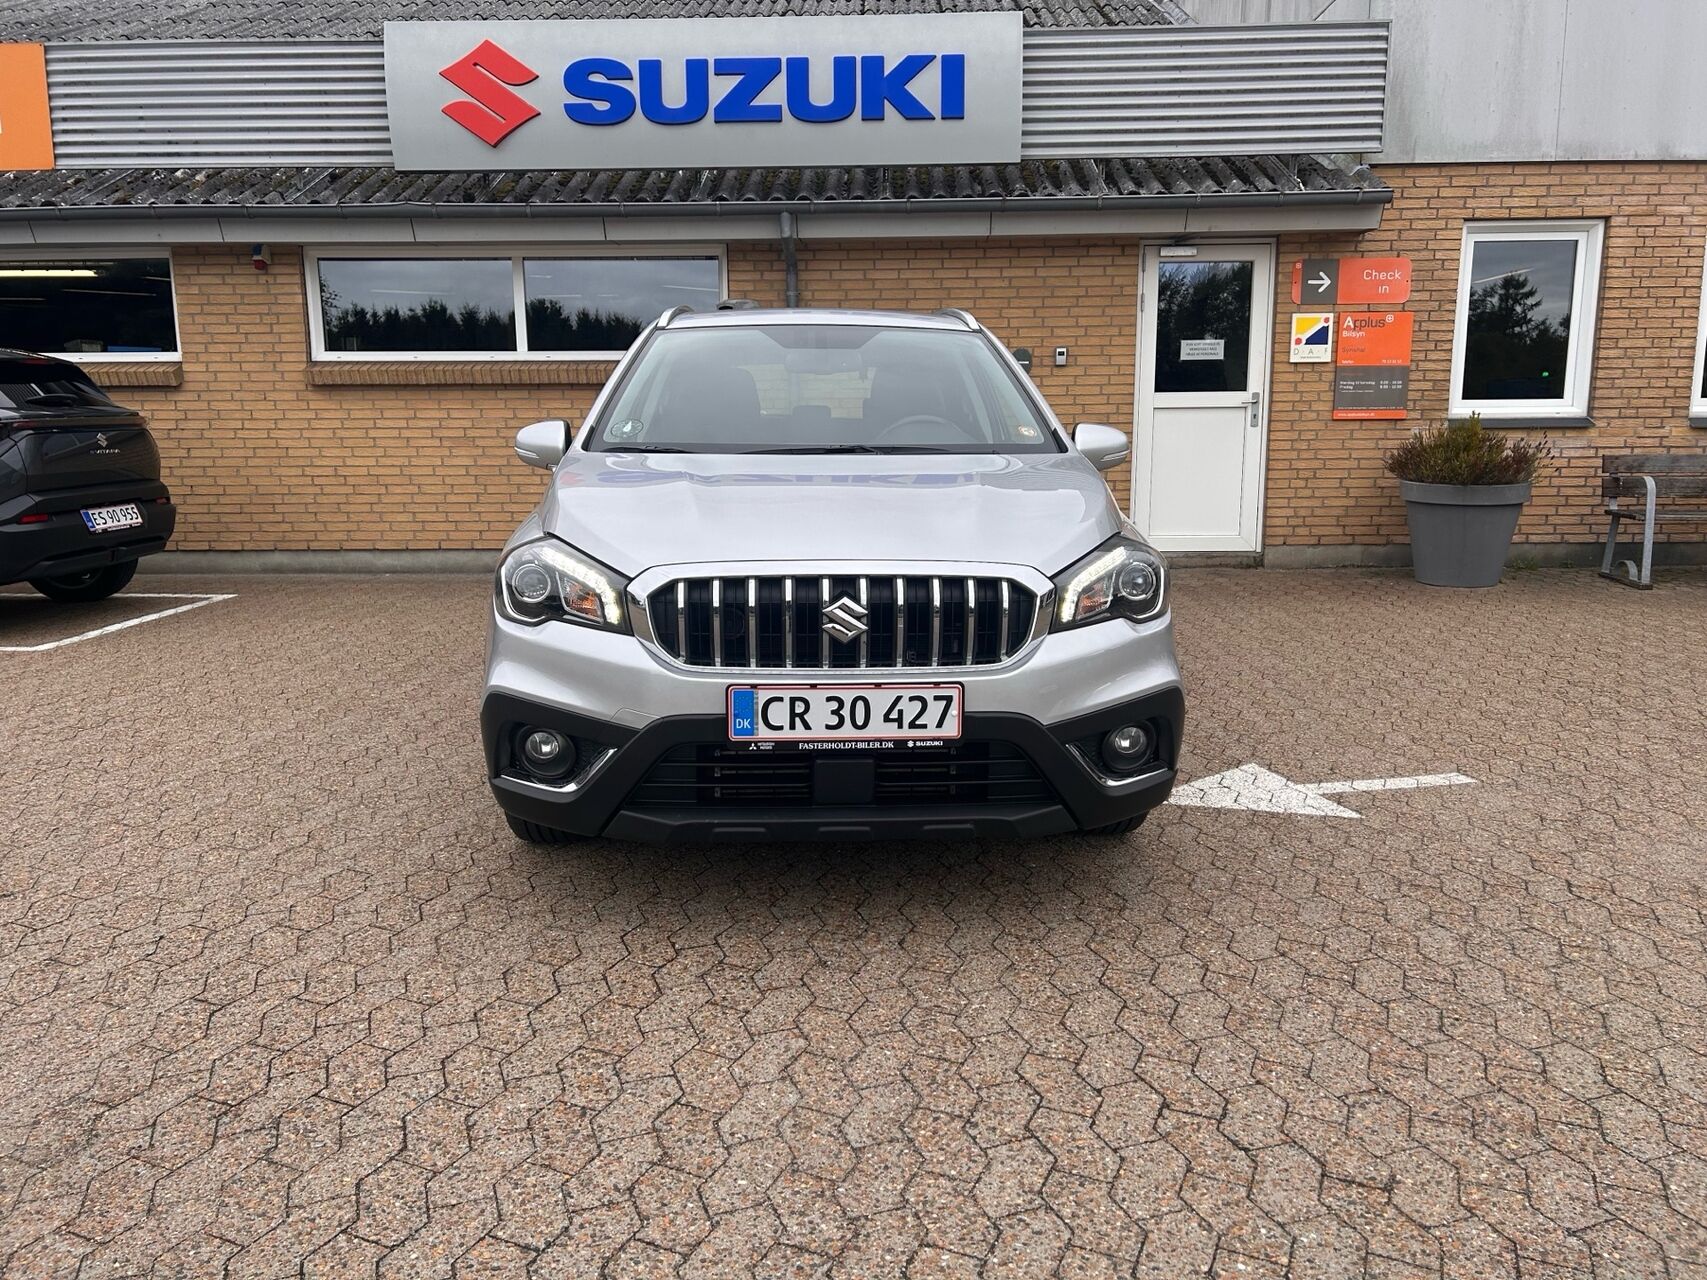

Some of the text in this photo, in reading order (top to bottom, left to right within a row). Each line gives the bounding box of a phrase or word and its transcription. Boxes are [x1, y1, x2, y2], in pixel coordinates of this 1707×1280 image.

[562, 53, 966, 126] SUZUKI
[1363, 269, 1402, 280] Check
[1378, 285, 1390, 294] in
[1342, 330, 1366, 339] Bilsyn
[91, 506, 139, 526] ES 90 955
[735, 695, 954, 731] DK CR 30 427
[798, 742, 895, 750] FASTERHOLDT-BILER.DK
